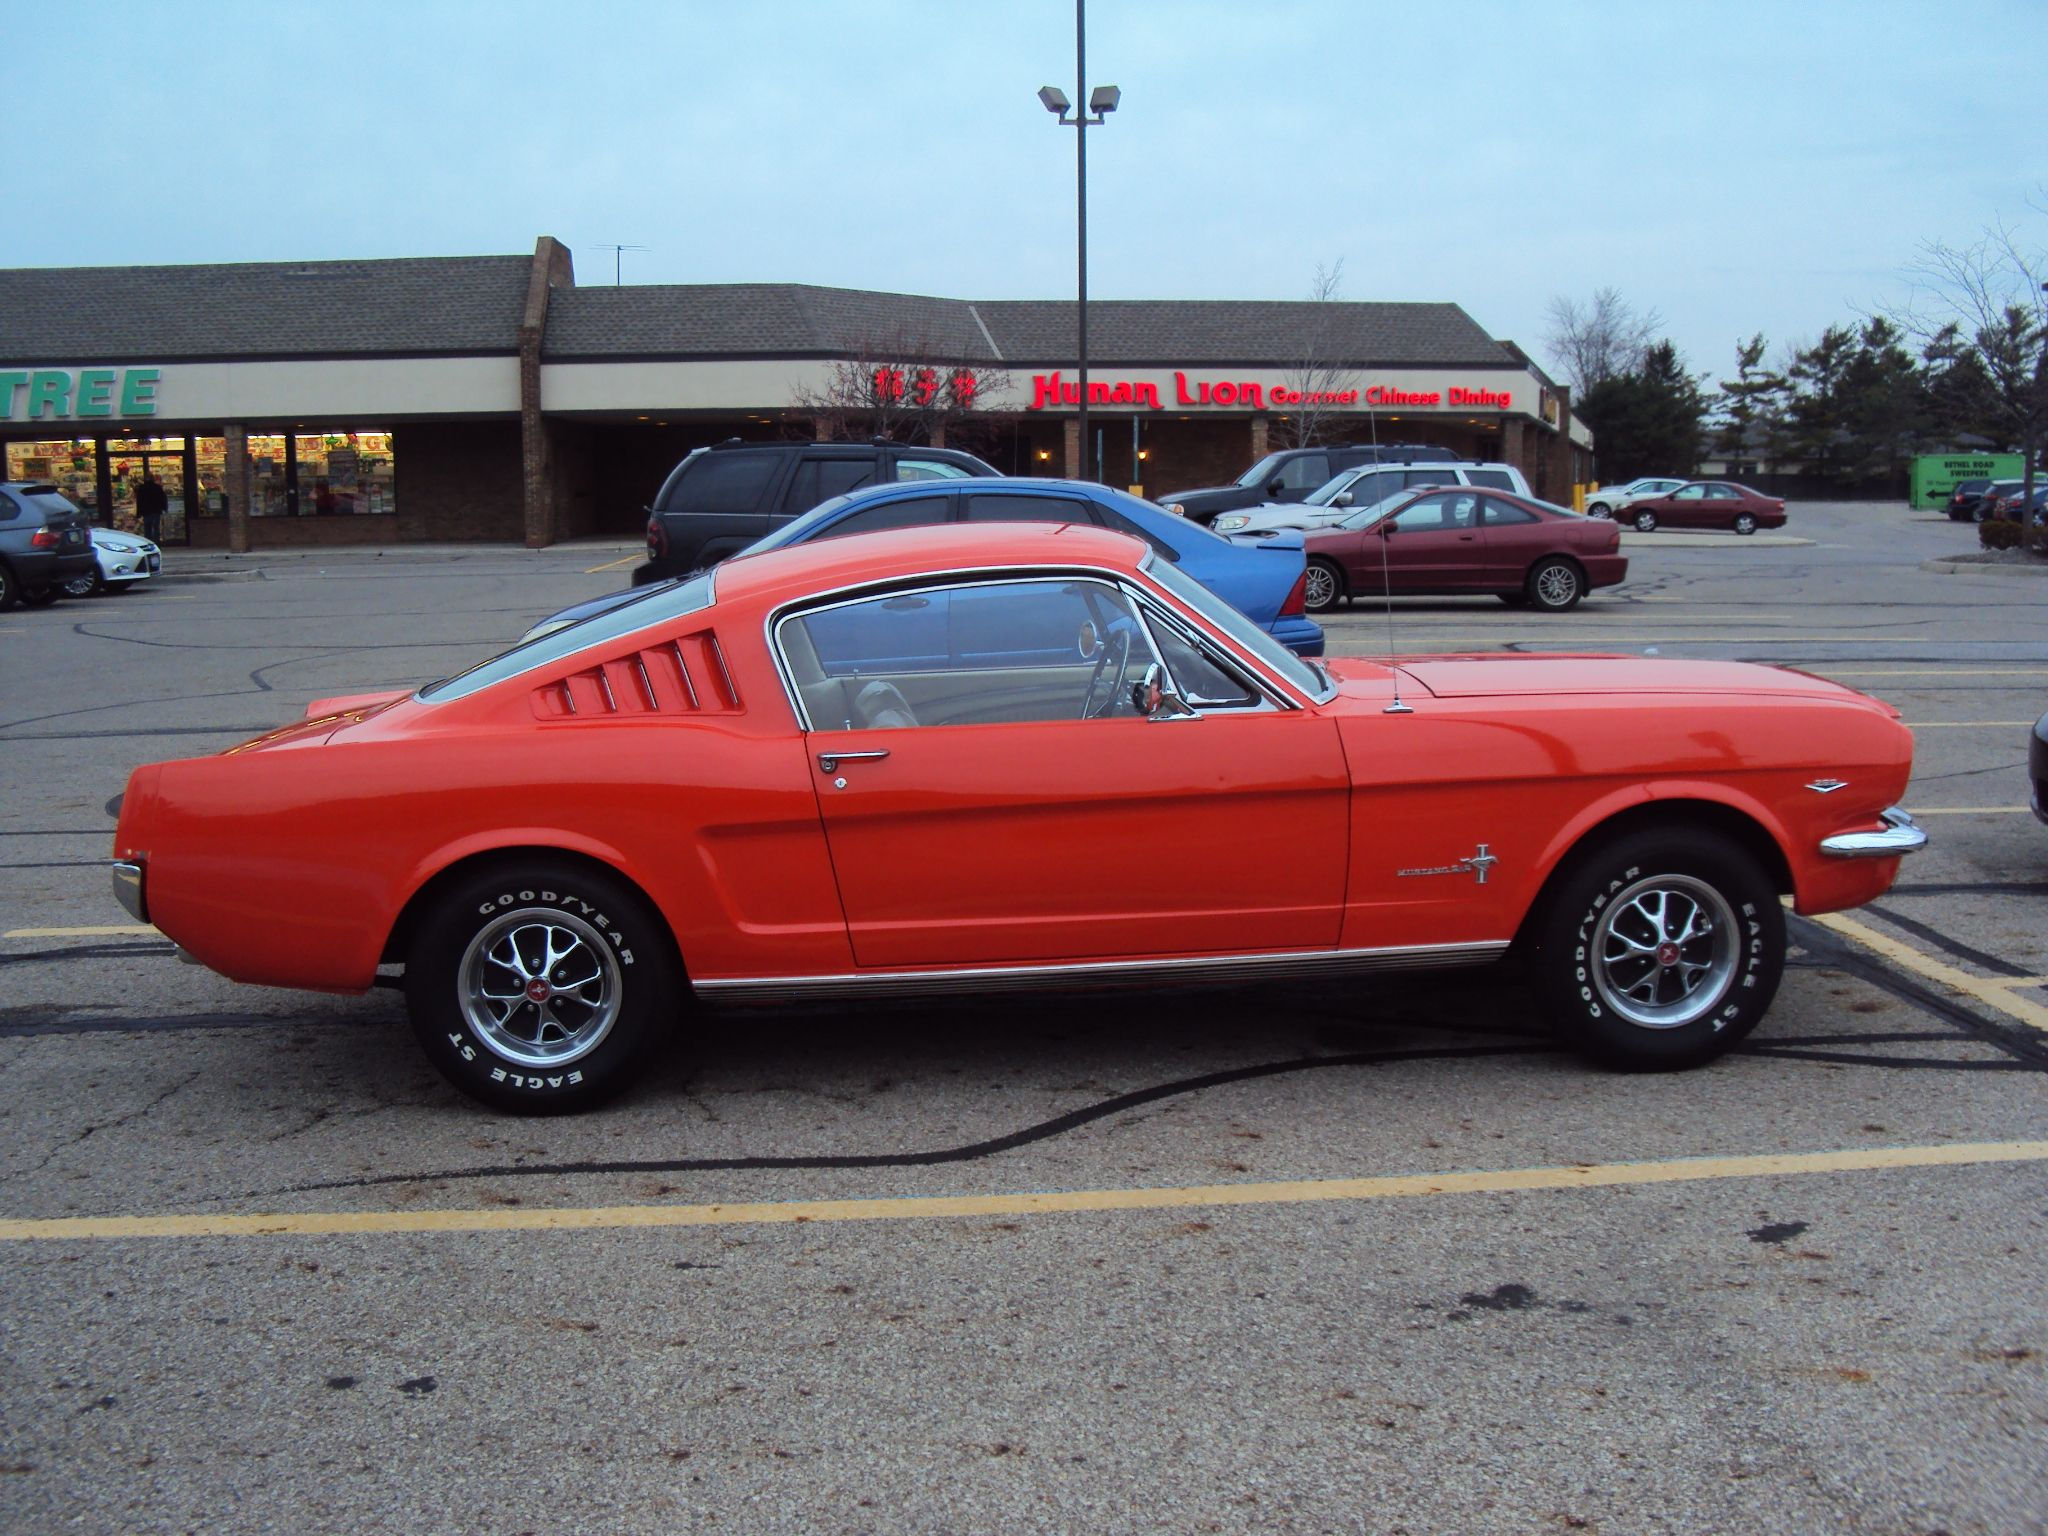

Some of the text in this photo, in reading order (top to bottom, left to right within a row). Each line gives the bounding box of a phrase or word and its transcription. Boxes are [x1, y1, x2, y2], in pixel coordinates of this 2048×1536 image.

[0, 369, 160, 418] TREE
[1026, 371, 1165, 409] Hunan
[1270, 385, 1358, 405] Gourmet
[1365, 386, 1441, 405] Chinese
[1448, 386, 1511, 409] Dining
[1972, 460, 1995, 469] ROAD
[478, 889, 635, 966] GOODYEAR
[1575, 866, 1640, 1018] GOODYEAR
[1712, 902, 1763, 1032] EAGLE ST
[448, 1031, 584, 1090] EAGLE ST
